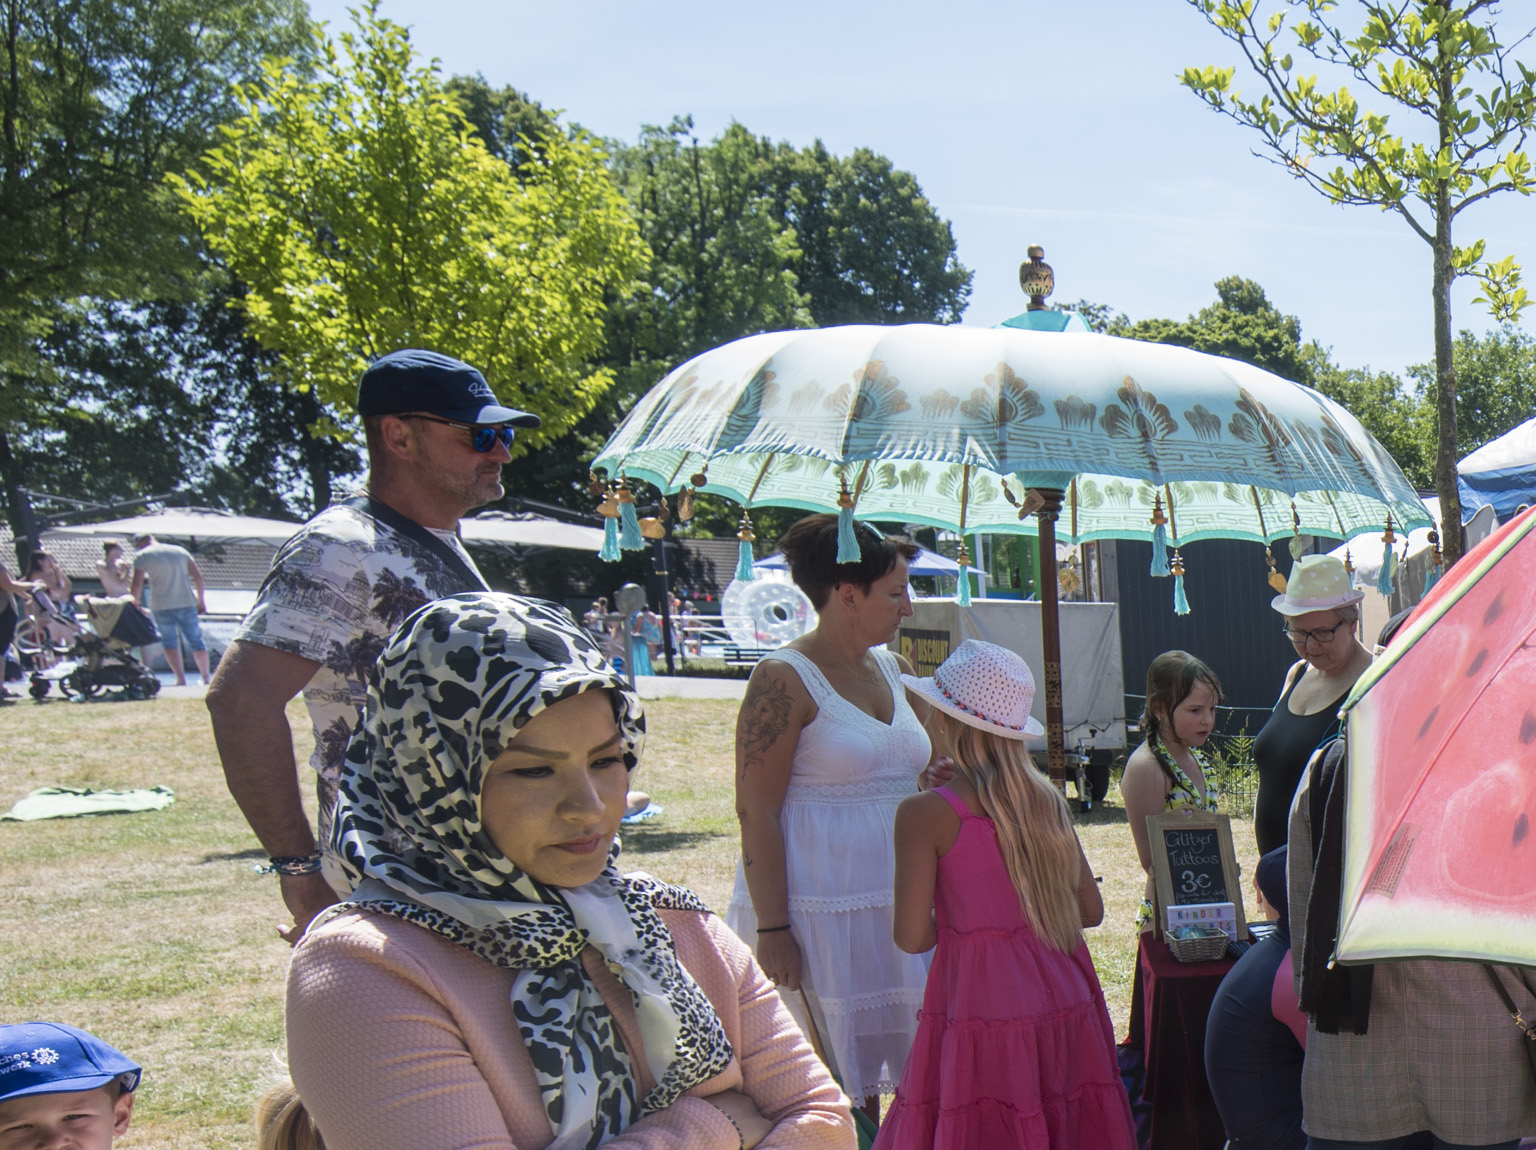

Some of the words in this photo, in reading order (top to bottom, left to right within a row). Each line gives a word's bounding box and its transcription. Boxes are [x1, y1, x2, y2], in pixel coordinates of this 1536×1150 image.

[1166, 831, 1212, 854] Glitzer
[1169, 850, 1219, 866] Tattoos
[1181, 870, 1212, 893] 3€
[1177, 908, 1222, 920] KINDER
